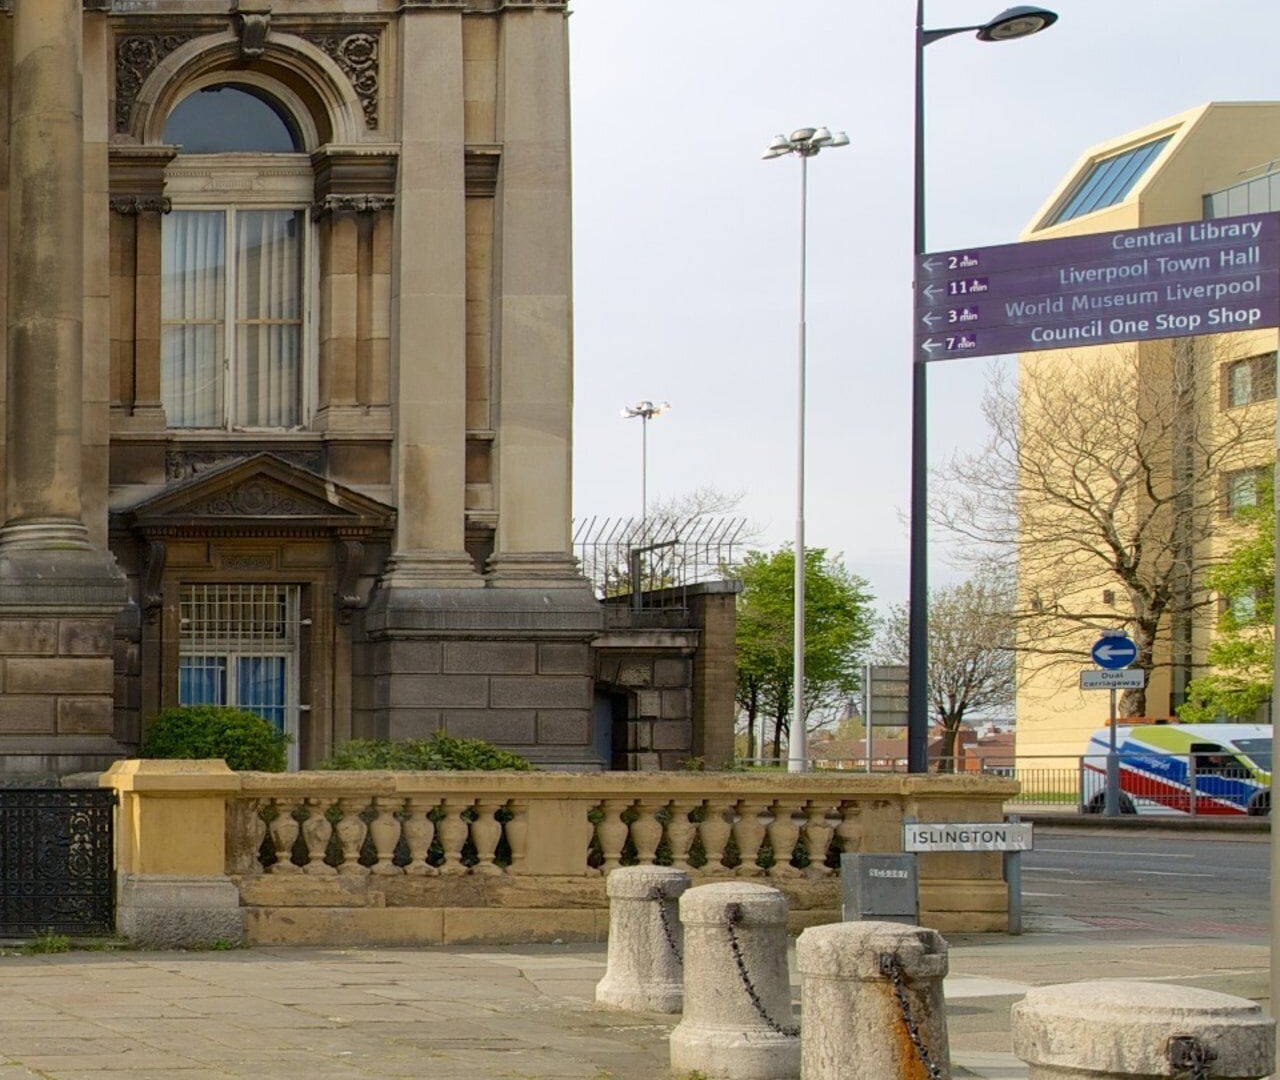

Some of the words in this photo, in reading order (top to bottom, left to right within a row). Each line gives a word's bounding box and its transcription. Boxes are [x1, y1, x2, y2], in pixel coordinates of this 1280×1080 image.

[1112, 226, 1182, 250] Central
[1190, 221, 1263, 242] Library
[948, 256, 958, 269] 2
[960, 258, 978, 268] min
[1060, 260, 1148, 284] Liverpool
[1157, 256, 1210, 274] Town
[1219, 246, 1260, 267] Hall
[950, 281, 967, 295] 11
[969, 283, 988, 293] min
[1005, 297, 1064, 318] World
[1072, 289, 1158, 311] Museum
[1167, 275, 1261, 301] Liverpool
[948, 309, 958, 323] 3
[959, 312, 978, 321] min
[1031, 320, 1102, 342] Council
[1109, 318, 1150, 335] One
[1155, 313, 1201, 330] Stop
[1207, 306, 1262, 325] Shop
[945, 337, 956, 350] 7
[957, 340, 976, 349] min
[1101, 671, 1124, 679] Dual
[1083, 679, 1141, 687] carriageway
[912, 830, 1007, 844] ISLINGTON
